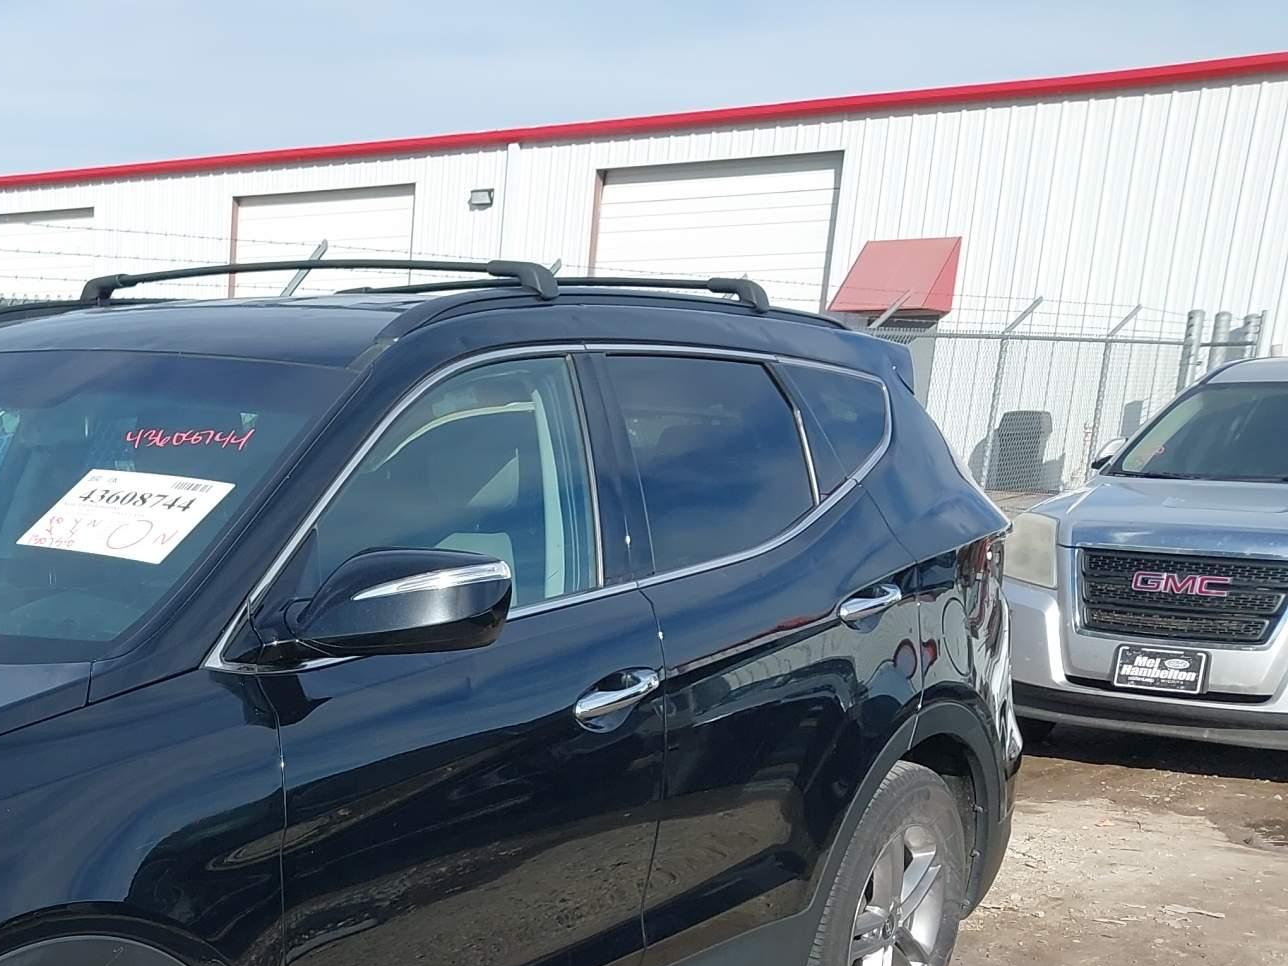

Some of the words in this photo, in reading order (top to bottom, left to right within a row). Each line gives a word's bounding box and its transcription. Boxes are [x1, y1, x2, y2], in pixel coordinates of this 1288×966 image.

[79, 488, 196, 512] 43608744
[1131, 570, 1233, 597] GMC
[1133, 656, 1161, 669] Mel
